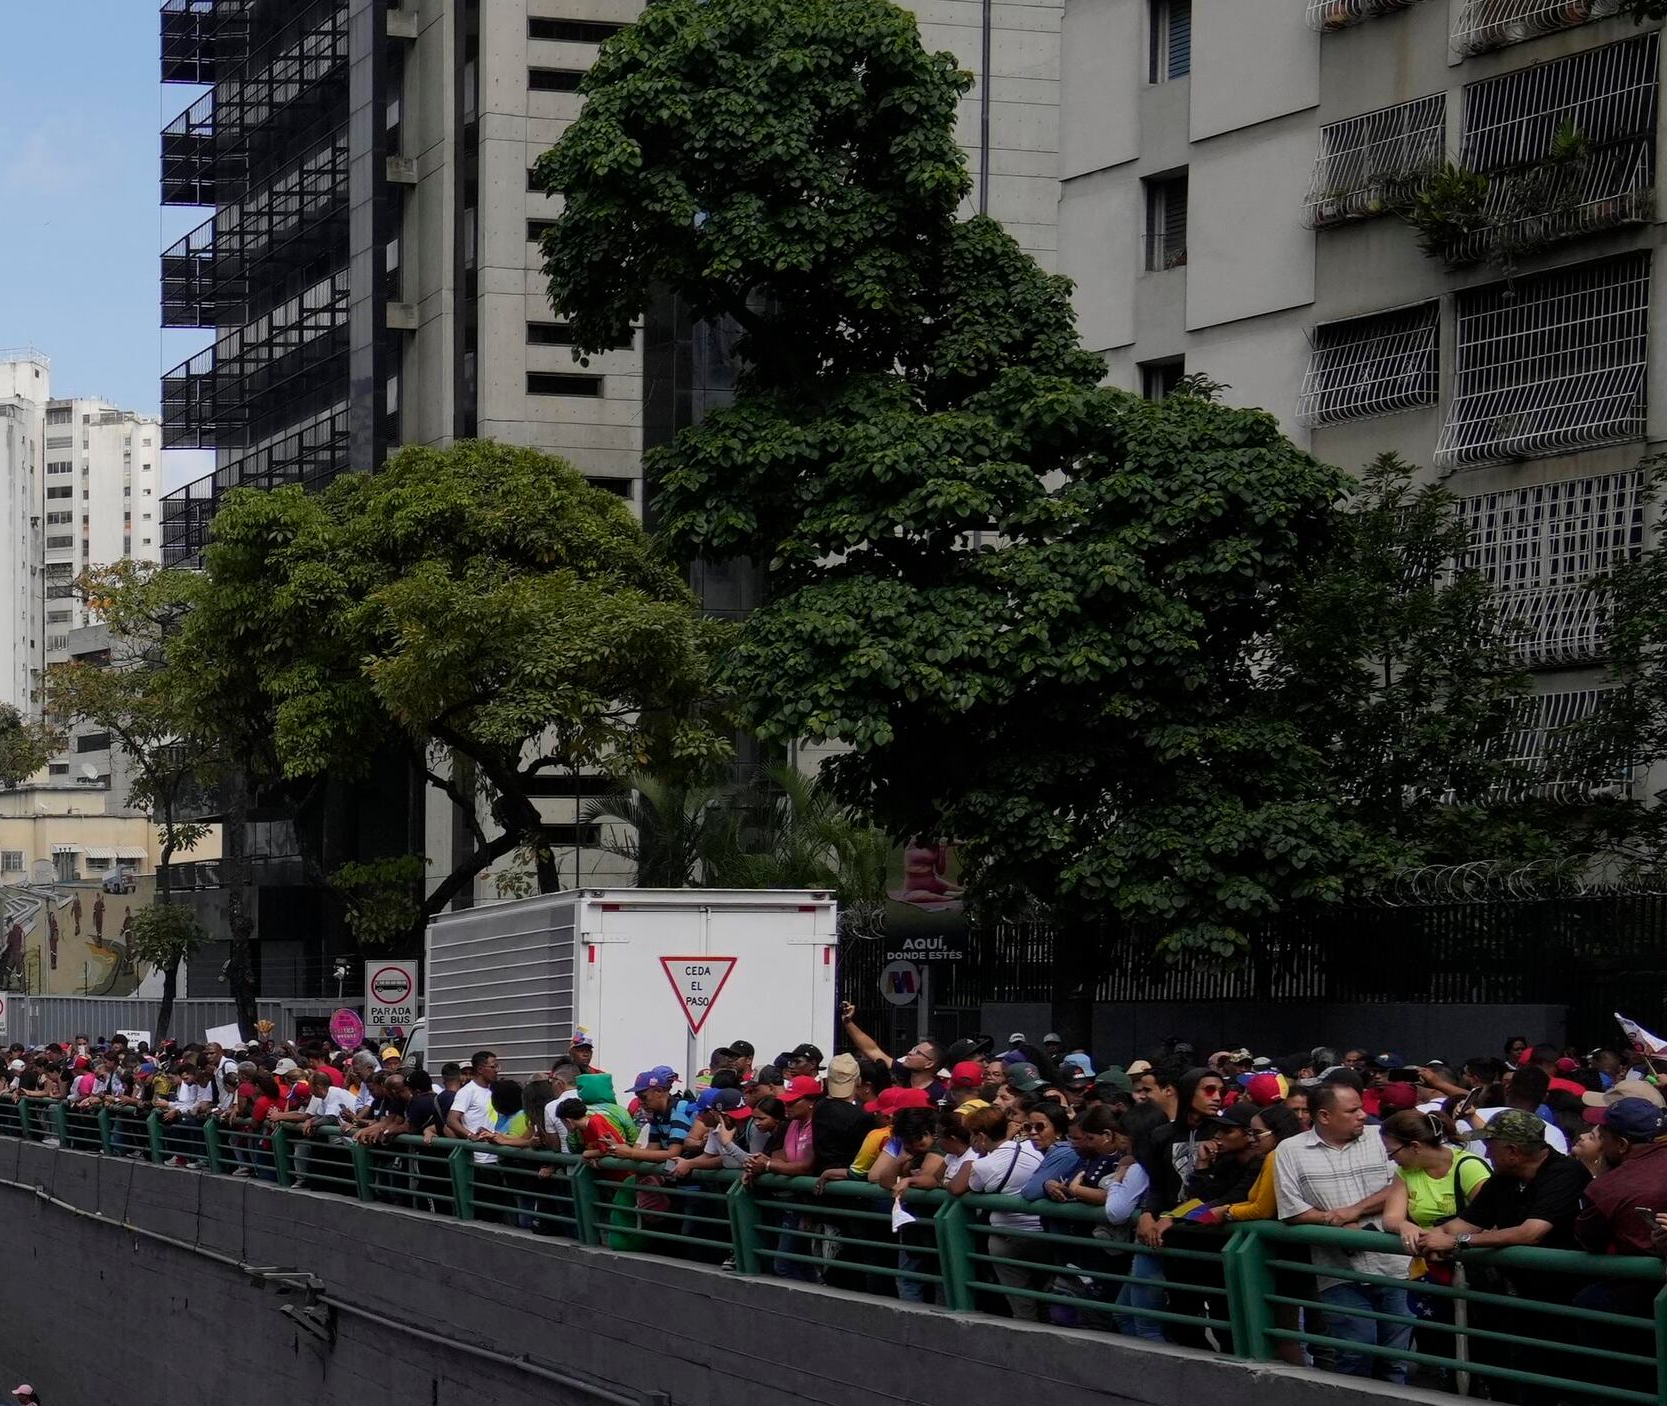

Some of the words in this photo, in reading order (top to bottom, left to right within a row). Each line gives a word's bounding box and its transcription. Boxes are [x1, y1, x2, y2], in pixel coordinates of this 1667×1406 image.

[902, 935, 948, 952] AQUÍ,
[887, 952, 926, 960] DONDE
[929, 950, 963, 960] ESTÉS
[685, 967, 711, 975] CEDA
[691, 982, 703, 990] EL
[686, 997, 709, 1006] PASO
[371, 1007, 411, 1015] PARADA
[373, 1016, 385, 1024] DE
[390, 1016, 411, 1024] BUS
